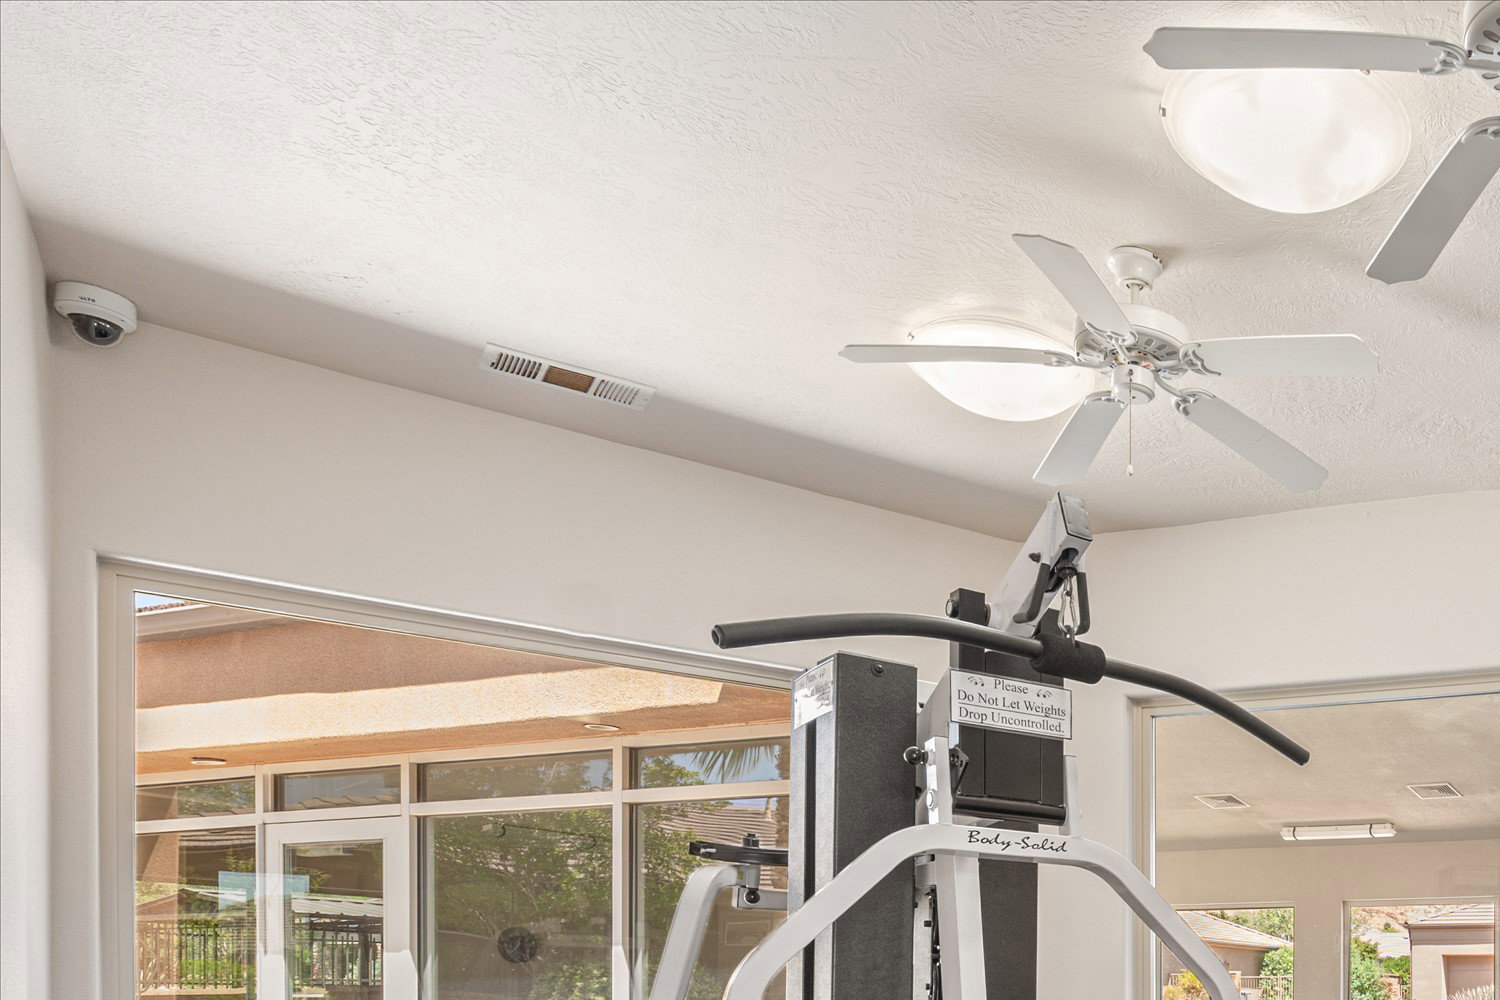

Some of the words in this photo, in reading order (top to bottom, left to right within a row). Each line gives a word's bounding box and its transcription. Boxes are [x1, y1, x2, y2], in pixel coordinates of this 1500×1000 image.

[994, 679, 1029, 695] Please
[957, 689, 974, 702] Do
[978, 693, 999, 706] Not
[1002, 697, 1020, 710] Let
[1024, 700, 1066, 717] Weights
[959, 706, 988, 723] Drop
[991, 712, 1065, 733] Uncontrolled.
[968, 829, 1068, 853] Body-Solid
